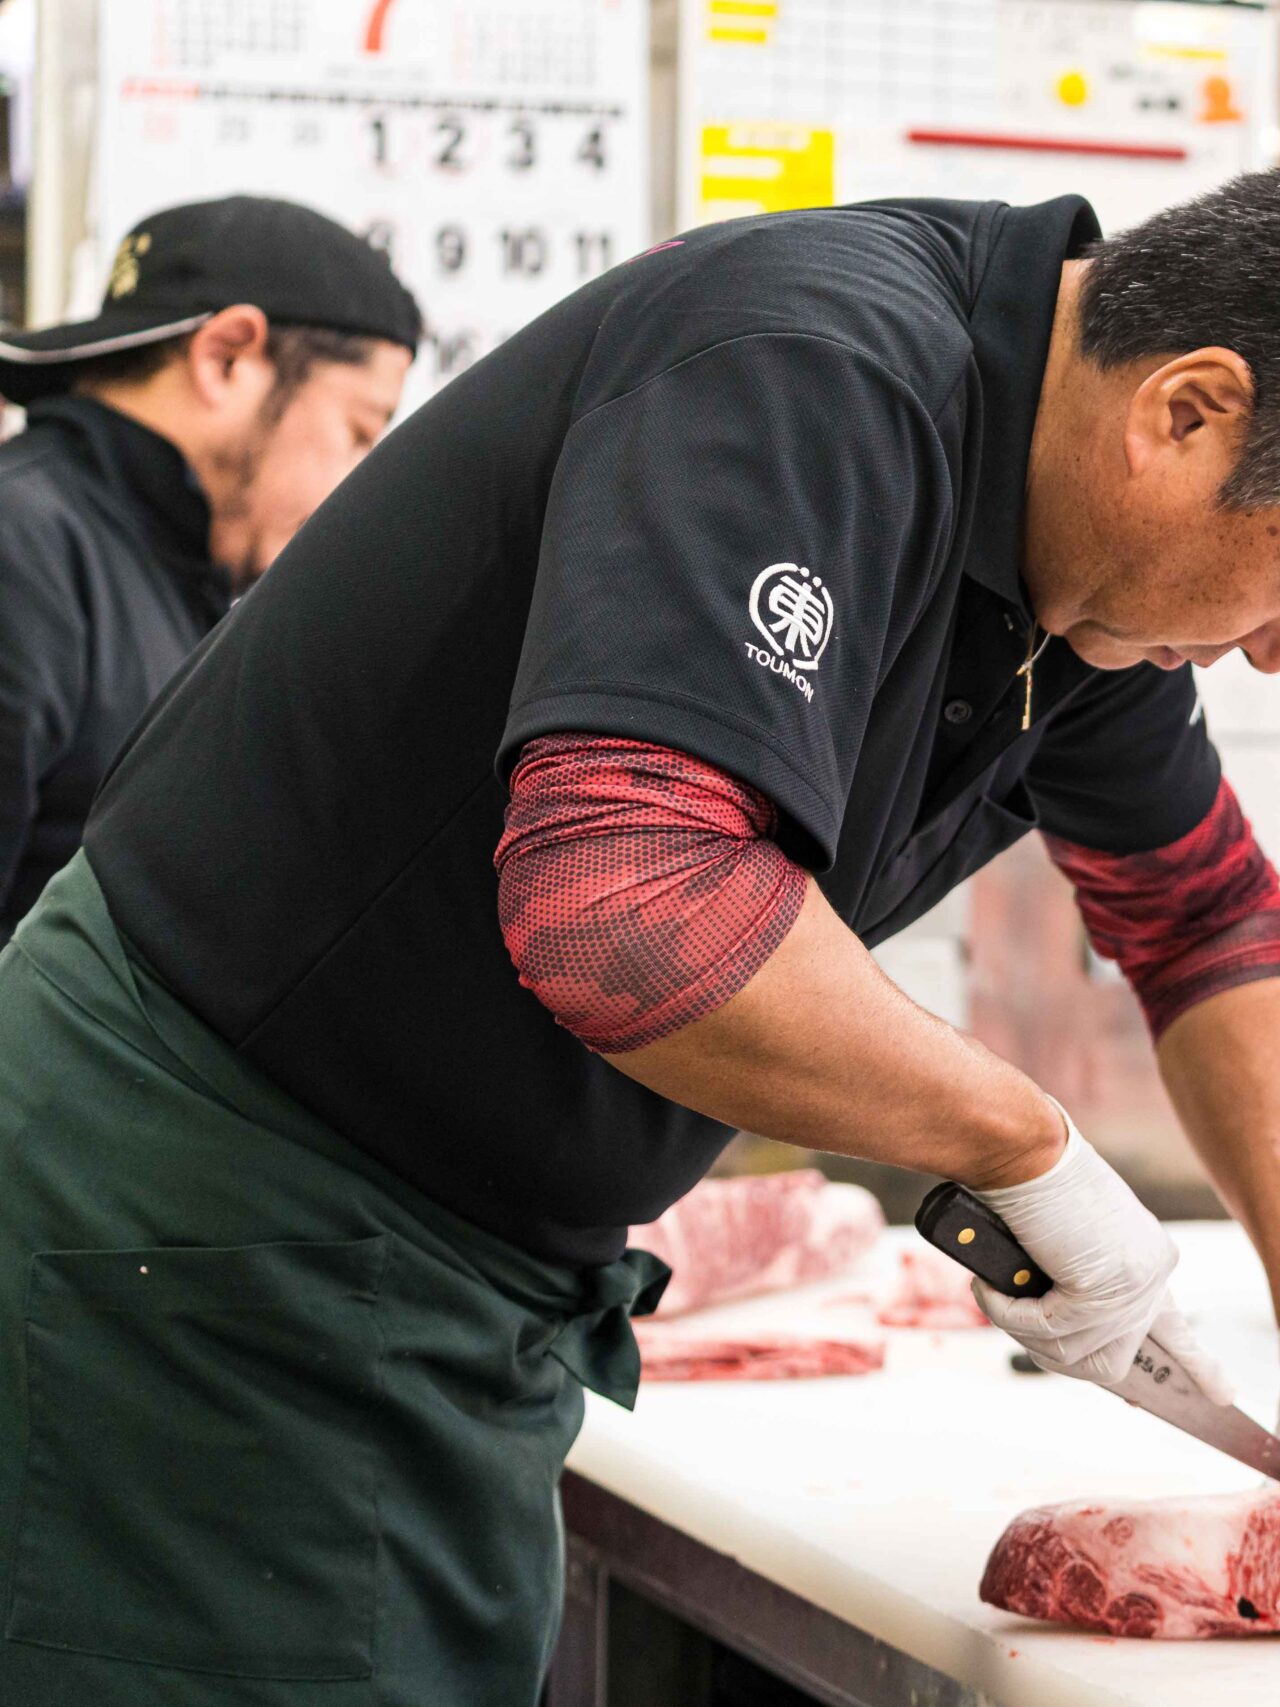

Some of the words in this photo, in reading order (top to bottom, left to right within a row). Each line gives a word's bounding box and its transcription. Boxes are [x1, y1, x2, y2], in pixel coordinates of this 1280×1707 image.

[370, 116, 389, 166] 1
[436, 116, 465, 169] 2
[509, 117, 536, 170] 3
[577, 122, 606, 170] 4
[436, 223, 466, 275] 9
[500, 225, 547, 277] 10
[576, 228, 613, 277] 11
[744, 641, 814, 703] TOUMON
